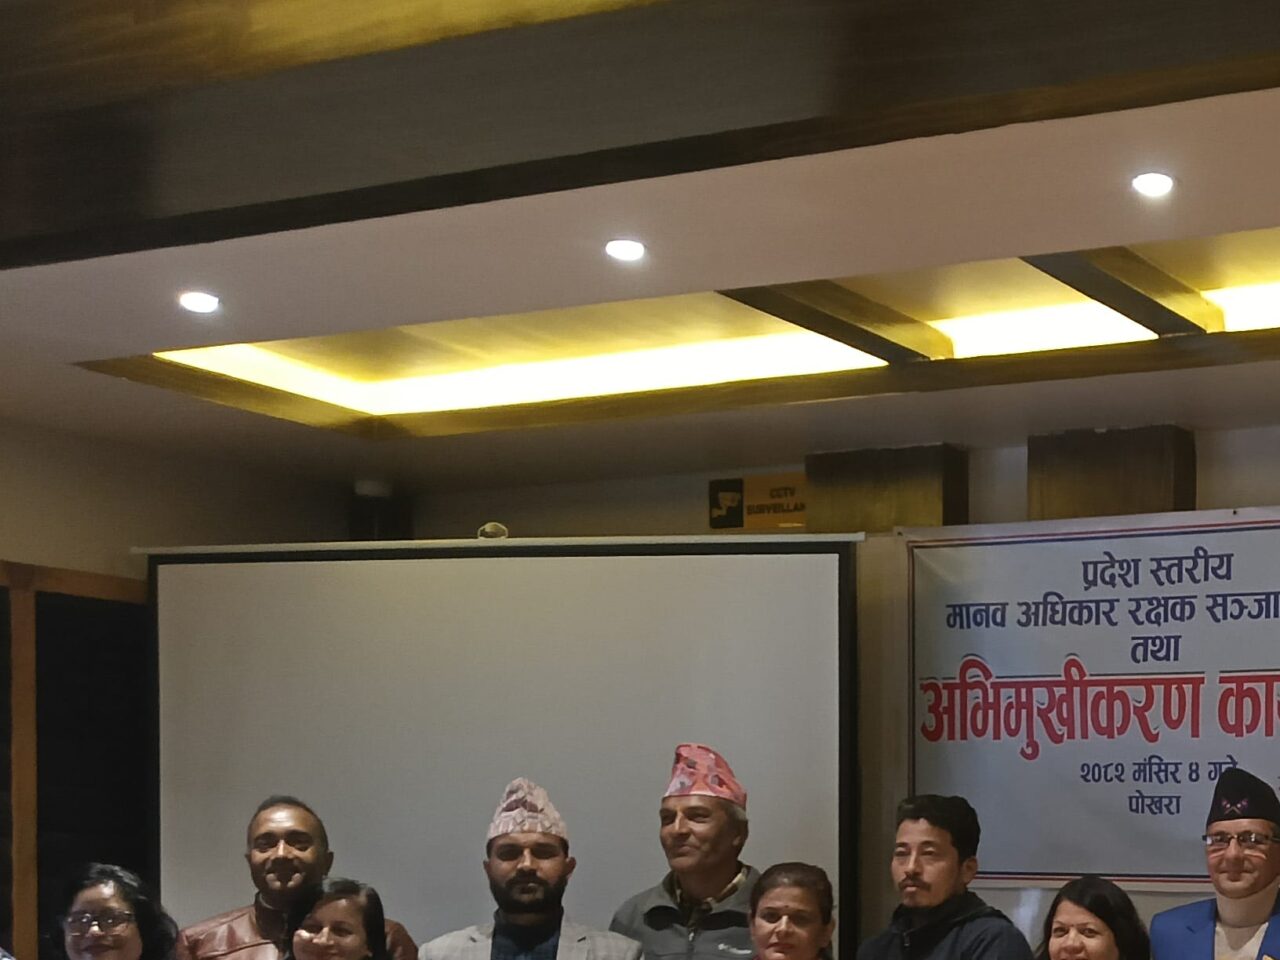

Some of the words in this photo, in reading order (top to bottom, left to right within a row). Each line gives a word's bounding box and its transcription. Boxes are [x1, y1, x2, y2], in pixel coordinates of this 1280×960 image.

[1082, 551, 1142, 591] प्रदेश
[1150, 546, 1234, 586] स्तरीय
[946, 602, 1008, 629] मानव
[1017, 591, 1120, 627] अधिकार
[1128, 595, 1197, 627] रक्षक
[1131, 634, 1181, 663] तथा
[919, 653, 1205, 761] अभिमुखीकरण
[1080, 761, 1126, 783] २०८२
[1132, 755, 1182, 784] मंसिर
[1188, 761, 1200, 782] ४
[1128, 790, 1181, 815] पोखरा
